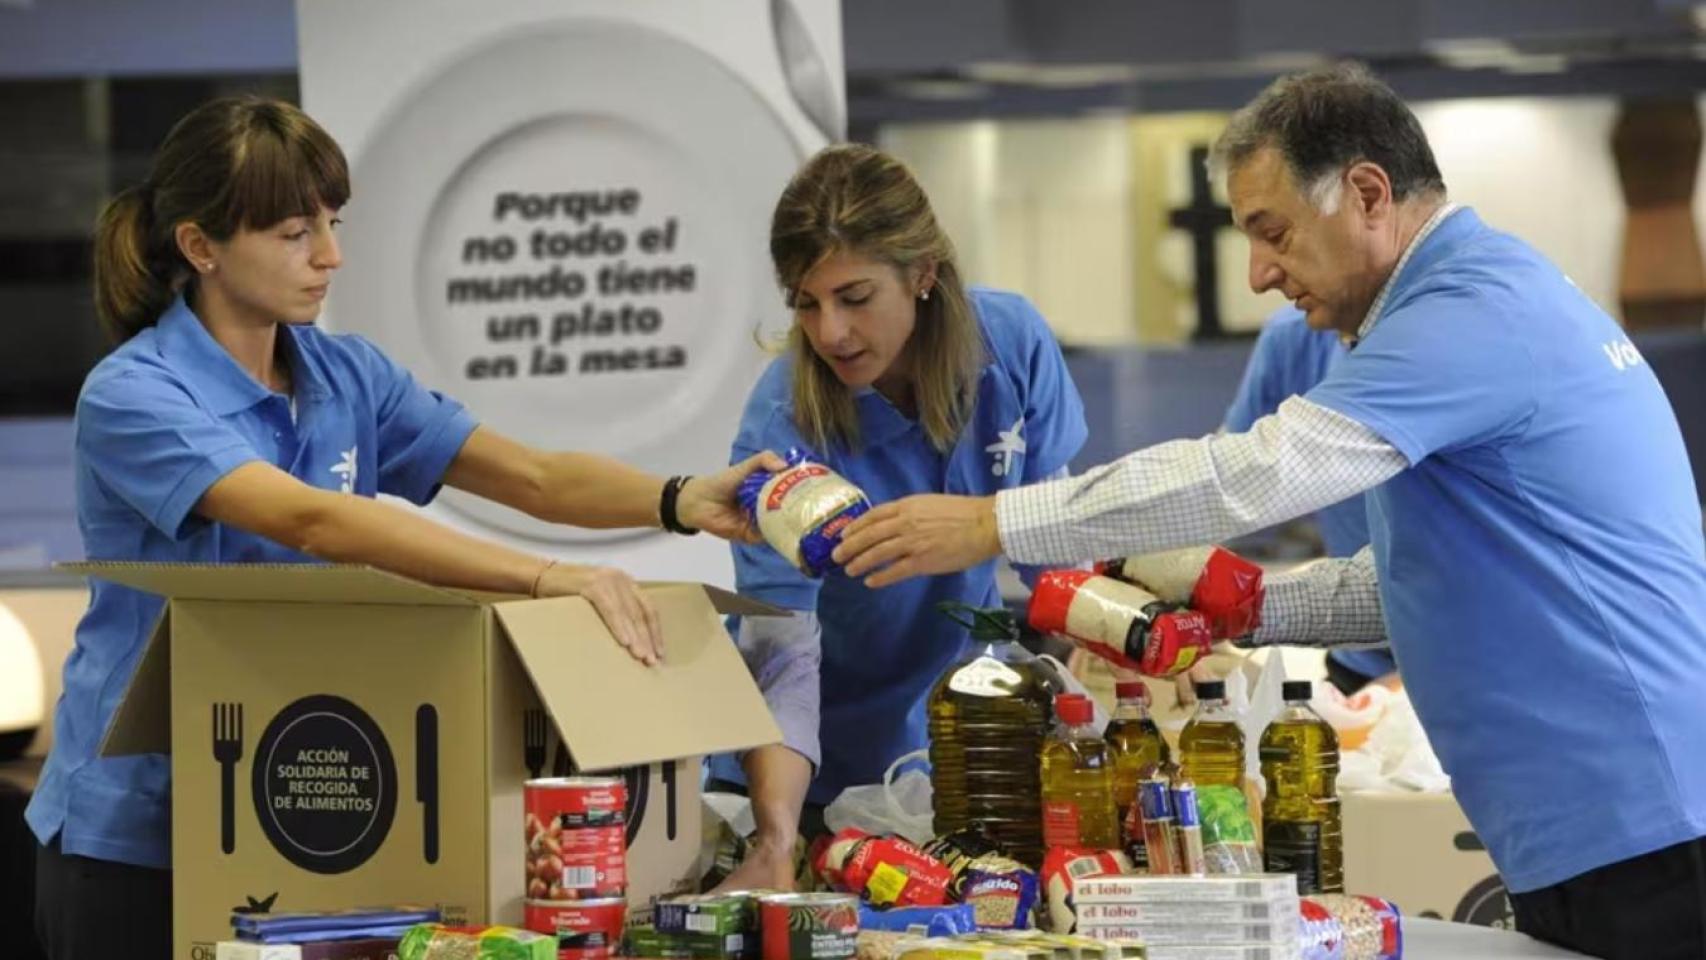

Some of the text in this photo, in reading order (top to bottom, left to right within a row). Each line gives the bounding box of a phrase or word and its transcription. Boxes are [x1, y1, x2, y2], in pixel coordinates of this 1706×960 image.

[494, 188, 640, 224] Porque
[462, 217, 678, 264] no todo el
[448, 259, 695, 303] mundo tiene
[487, 303, 662, 345] un plato
[466, 345, 687, 379] en la mesa
[297, 746, 349, 763] ACCIÓN
[277, 765, 369, 779] SOLIDARIA DE
[289, 781, 358, 795] RECOGIDA
[274, 796, 373, 811] DE ALIMENTOS
[1098, 883, 1132, 895] lobo
[1103, 906, 1137, 918] lobo
